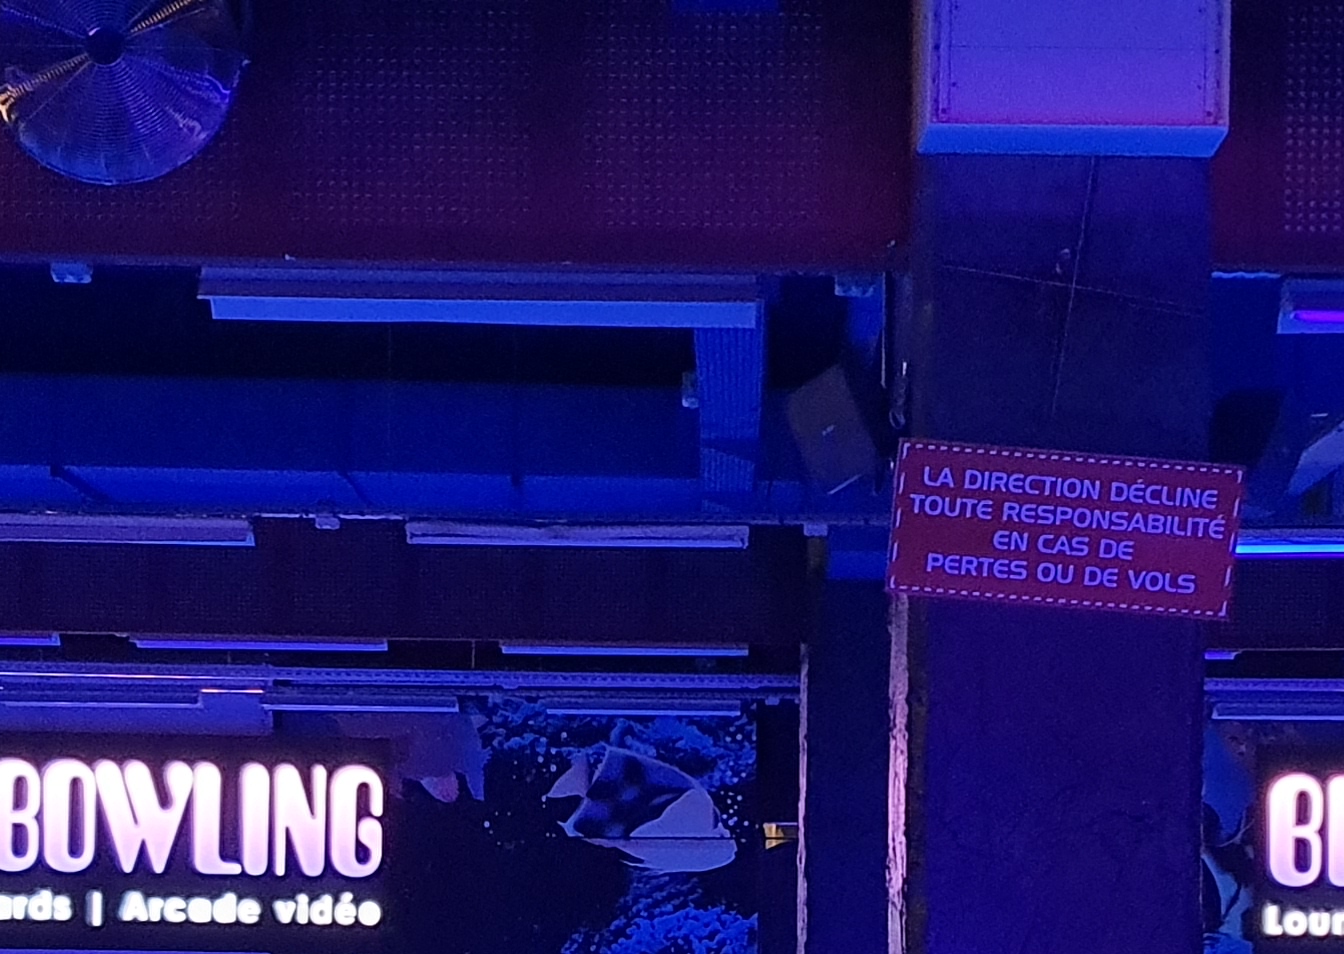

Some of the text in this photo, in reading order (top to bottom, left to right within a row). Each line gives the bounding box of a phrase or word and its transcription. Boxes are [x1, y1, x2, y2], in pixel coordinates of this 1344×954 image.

[923, 465, 1218, 510] LA DIRECTION DÉCLINE
[909, 493, 1227, 539] TOUTE RESPONSABILITÉ
[992, 529, 1135, 561] EN CAS DE
[926, 552, 1196, 594] PERTES OU DE VOLS
[118, 888, 262, 925] Arcade
[272, 889, 383, 928] vidéo
